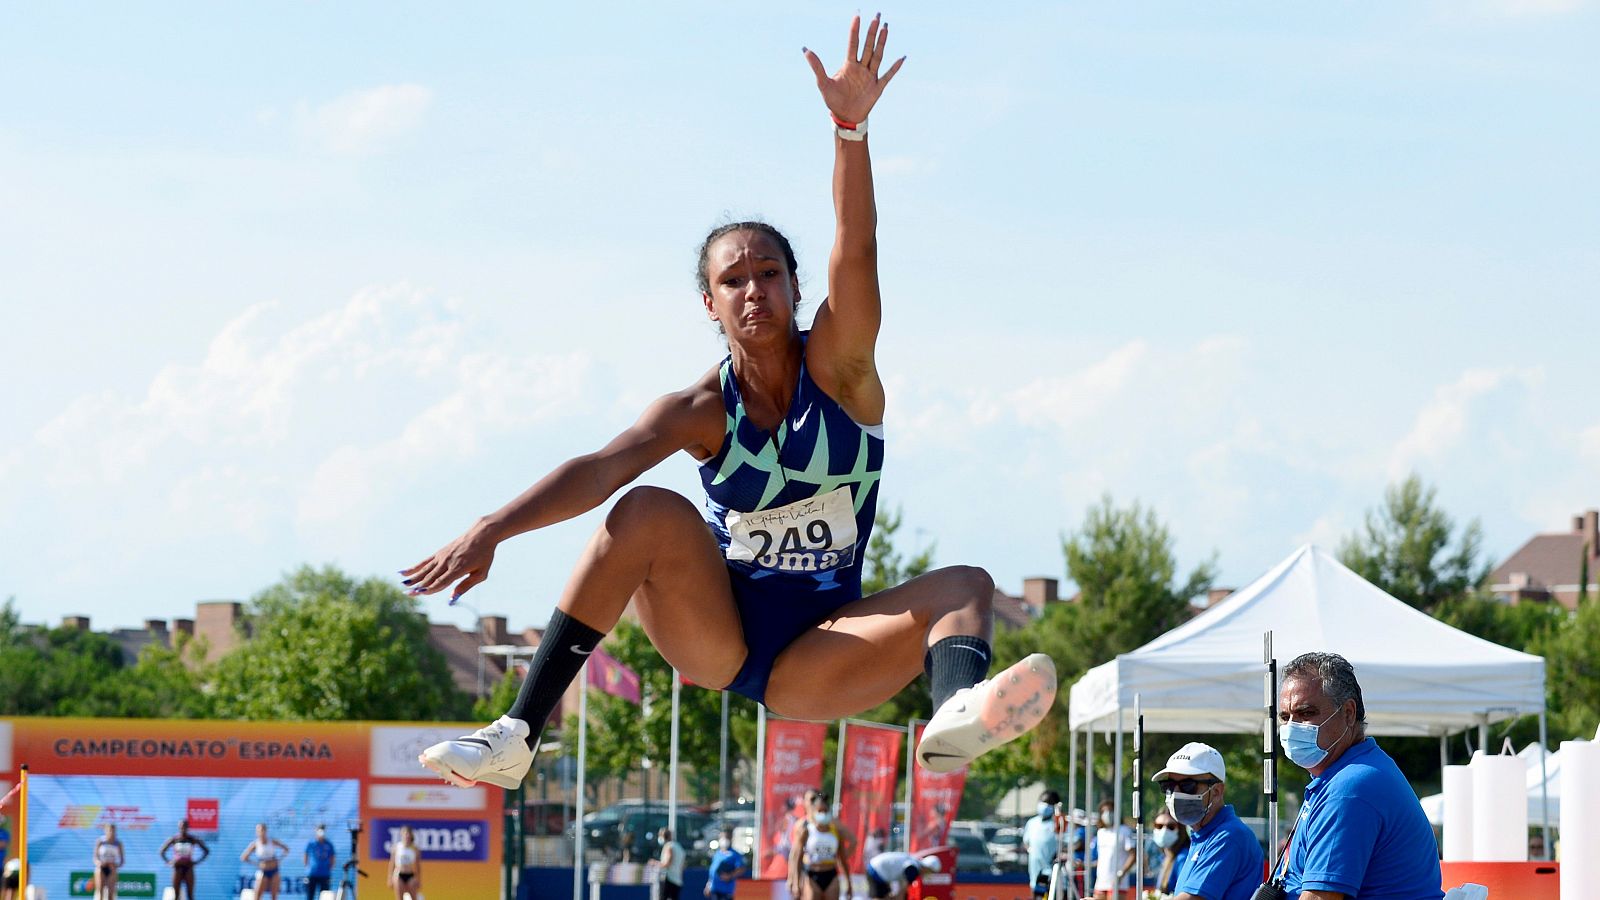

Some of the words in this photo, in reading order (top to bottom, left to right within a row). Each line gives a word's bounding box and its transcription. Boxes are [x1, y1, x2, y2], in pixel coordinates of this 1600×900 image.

[749, 519, 833, 560] 249
[757, 550, 839, 571] oma
[54, 738, 226, 758] CAMPEONATO
[239, 737, 333, 760] ESPAÑA
